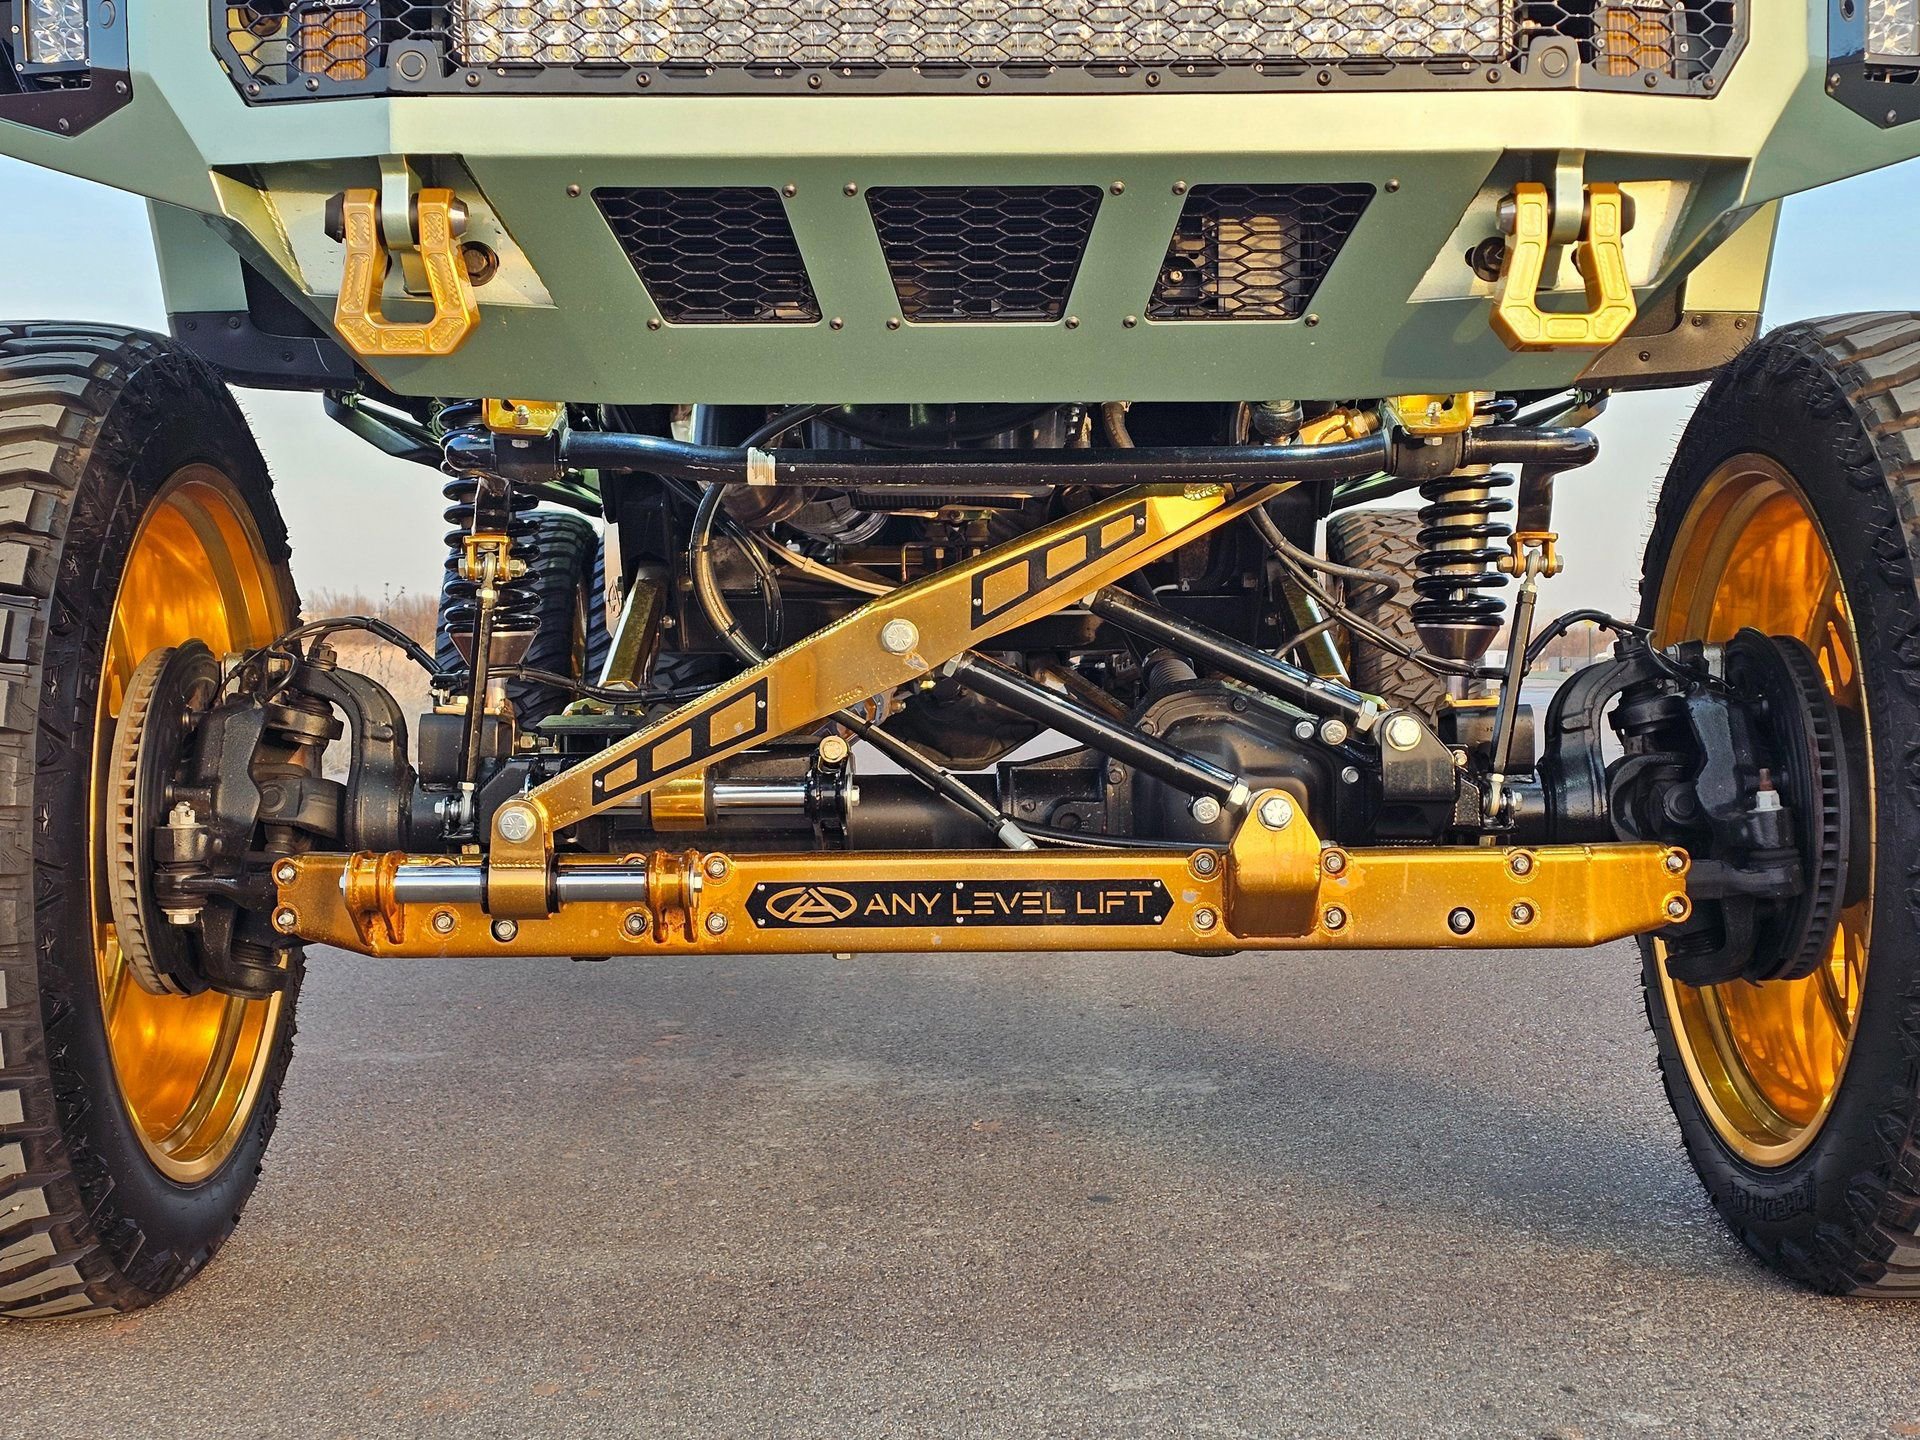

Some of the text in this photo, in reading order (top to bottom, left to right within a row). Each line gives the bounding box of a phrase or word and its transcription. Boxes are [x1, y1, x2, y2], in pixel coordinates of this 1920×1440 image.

[863, 890, 1153, 916] ANY LEVEL LIFT
